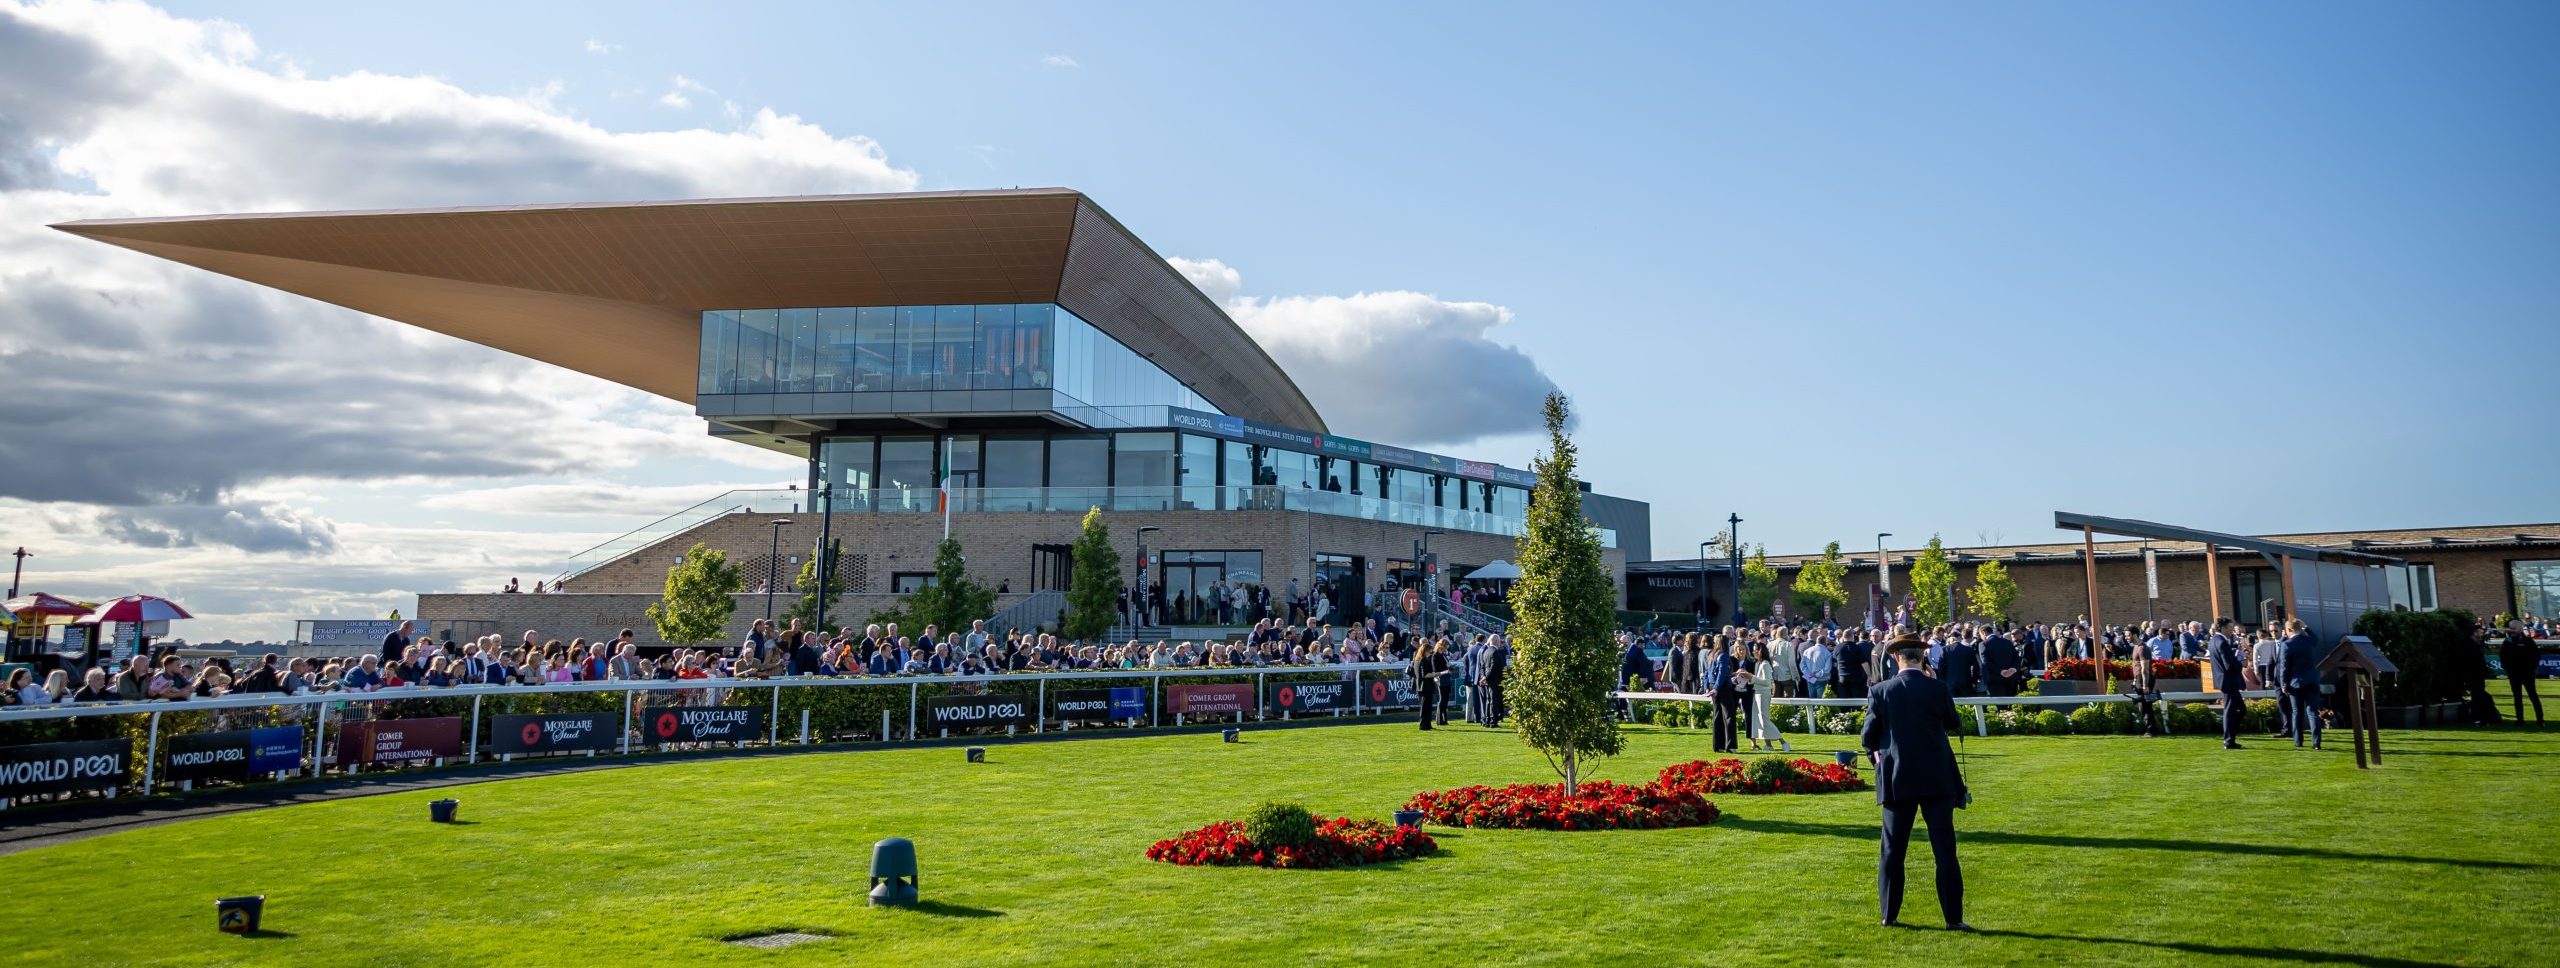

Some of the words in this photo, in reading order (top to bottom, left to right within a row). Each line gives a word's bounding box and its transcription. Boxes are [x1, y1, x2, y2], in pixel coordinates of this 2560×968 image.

[1173, 413, 1196, 426] WORLD
[1196, 417, 1213, 429] POOL
[1648, 577, 1696, 589] WELCOME
[594, 613, 615, 625] The
[621, 613, 640, 627] Aga
[1296, 685, 1342, 697] MOYGLARE
[1388, 680, 1413, 692] MOYG
[1188, 694, 1212, 702] COMER
[1213, 693, 1236, 701] GROUP
[1304, 693, 1331, 709] Stud
[1057, 701, 1087, 711] WORLD
[1087, 700, 1108, 709] POOL
[1188, 703, 1241, 711] INTERNATIONAL
[681, 710, 748, 725] MOYGLARE
[935, 705, 986, 721] WORLD
[989, 703, 1025, 717] POOL
[543, 720, 593, 732] MOYGLARE
[692, 721, 731, 738] Stud
[377, 731, 404, 741] COMER
[551, 730, 579, 744] Stud
[376, 741, 402, 751] GROUP
[172, 750, 215, 766] WORLD
[216, 748, 245, 762] POOL
[375, 749, 433, 760] INTERNATIONAL
[0, 758, 69, 786] WORLD
[73, 754, 123, 778] POOL
